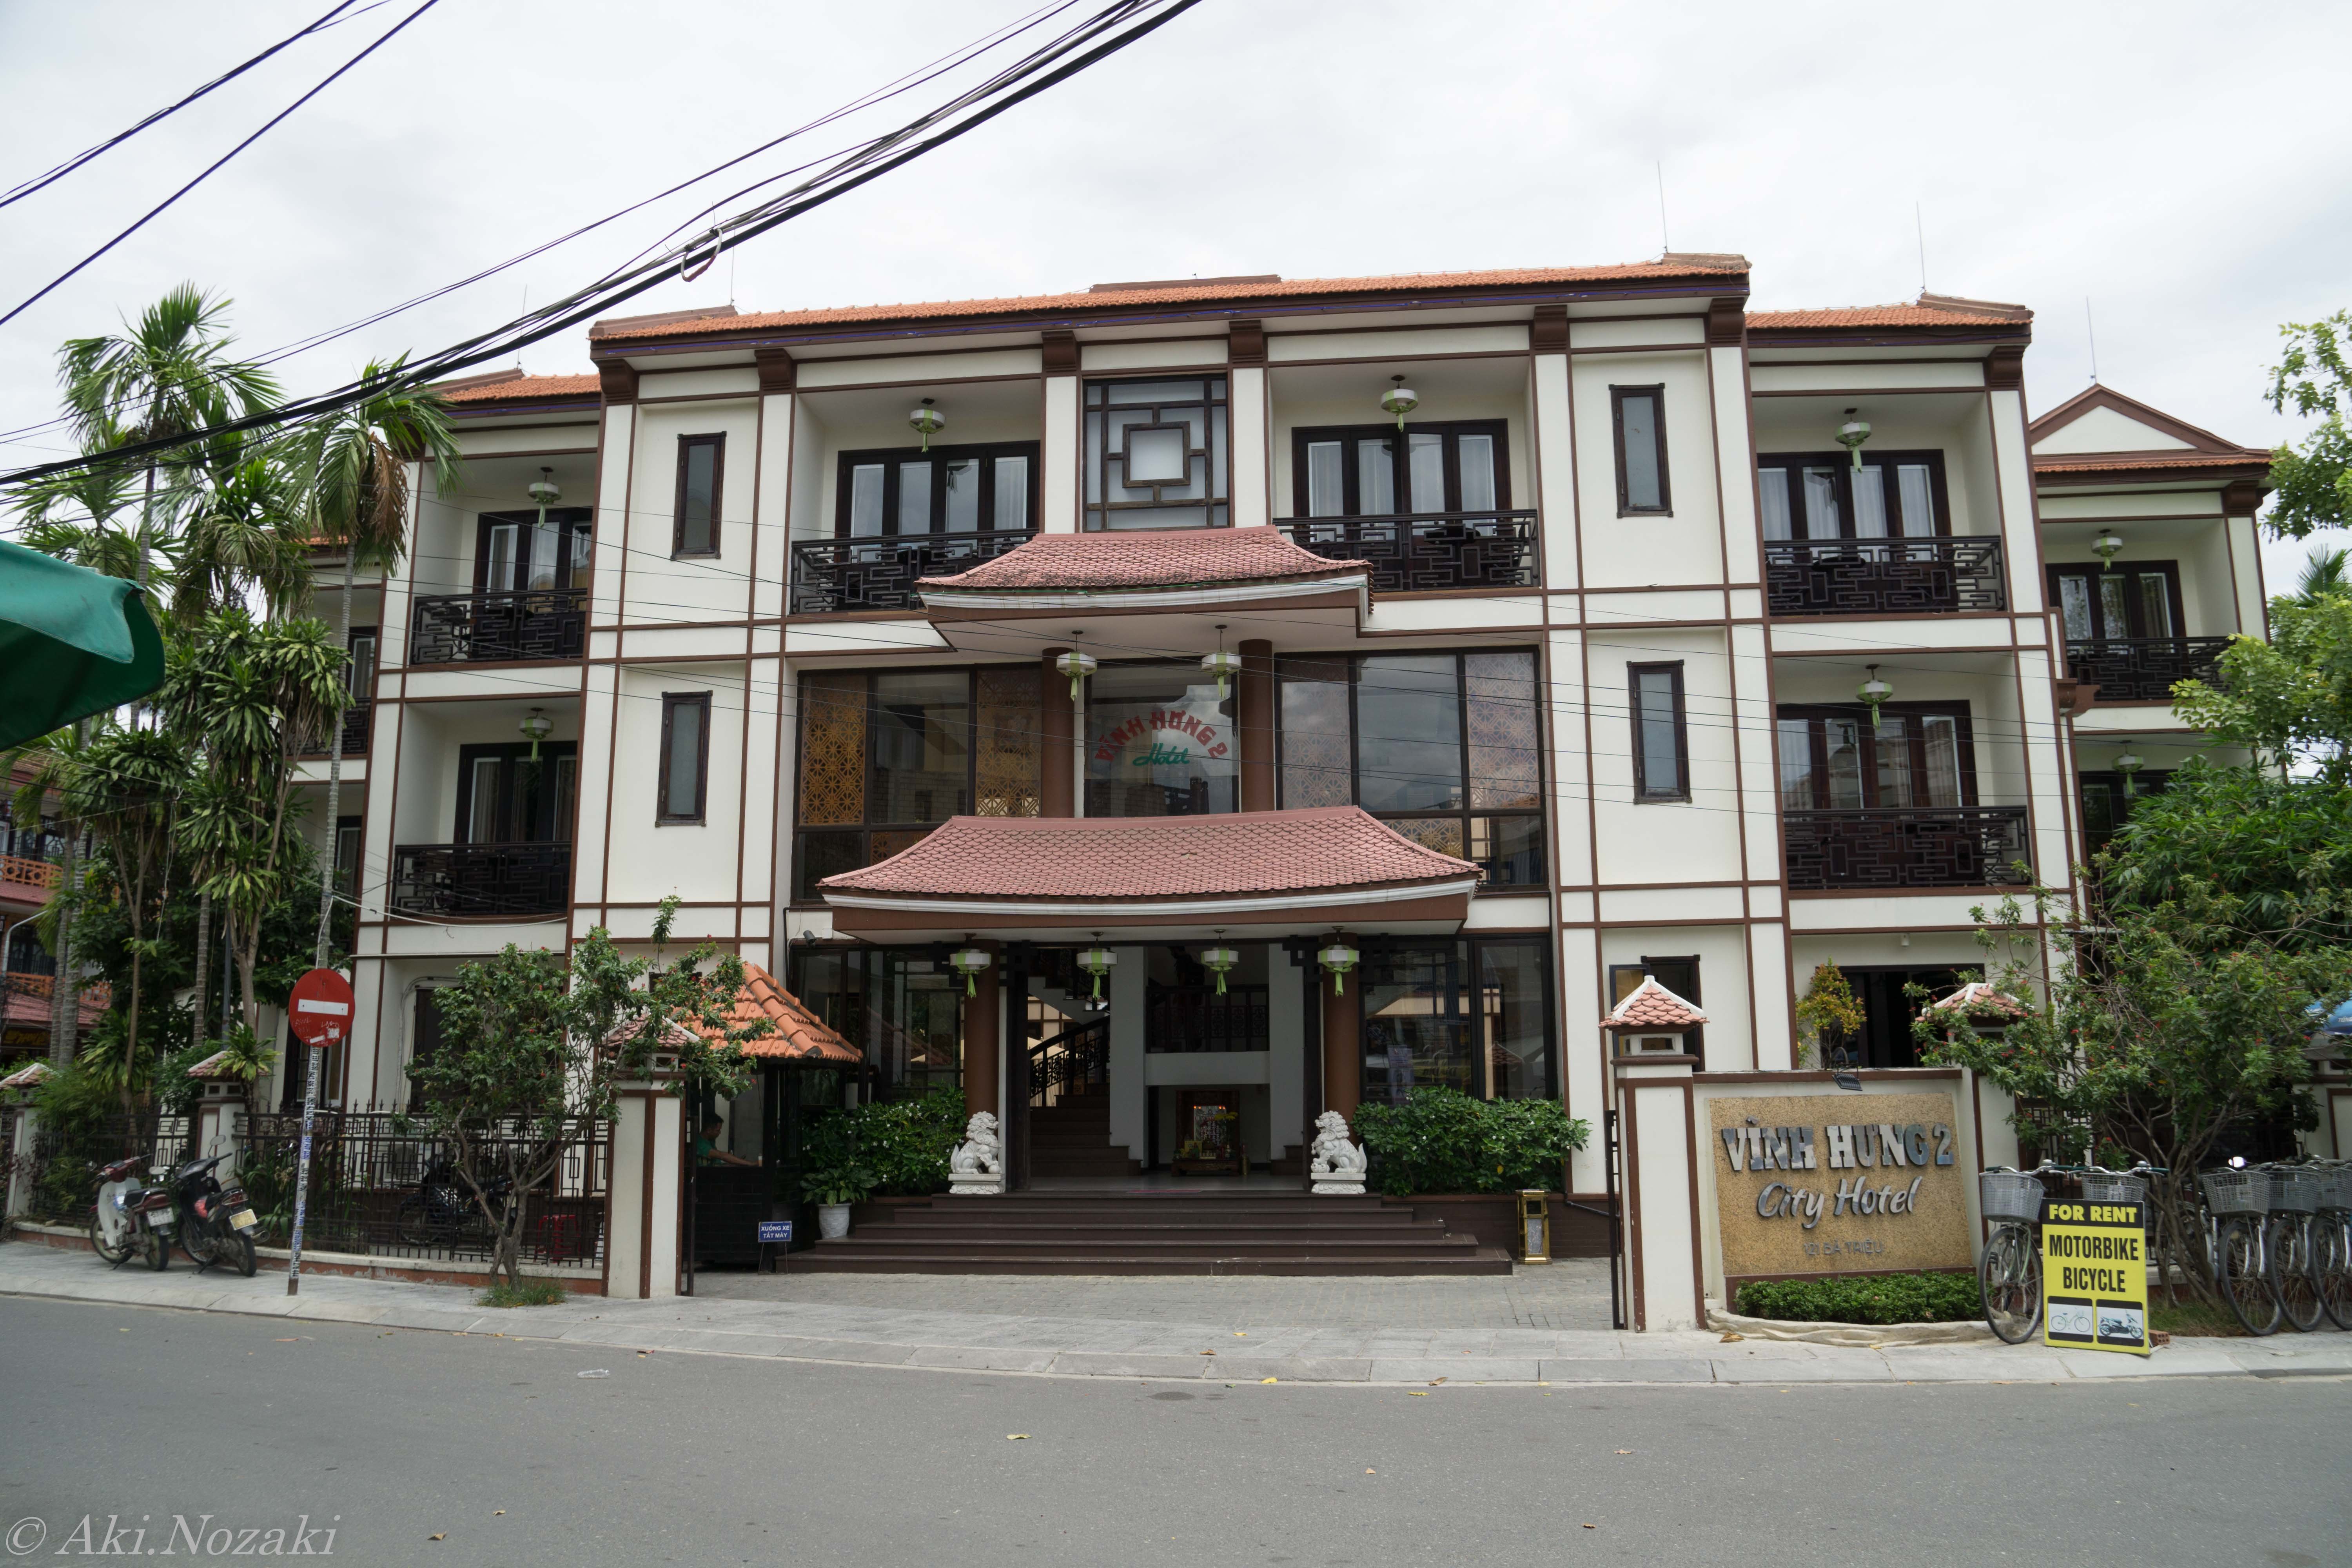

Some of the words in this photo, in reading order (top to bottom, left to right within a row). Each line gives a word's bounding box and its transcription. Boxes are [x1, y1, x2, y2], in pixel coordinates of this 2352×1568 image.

[1132, 743, 1190, 766] Hotel
[1207, 741, 1228, 759] 2
[1825, 1124, 1929, 1168] HƯNG
[1933, 1123, 1954, 1165] 2
[1757, 1181, 1825, 1229] City
[1834, 1176, 1923, 1216] Hotel
[2049, 1204, 2085, 1221] FOR
[2090, 1205, 2137, 1223] RENT
[2049, 1234, 2139, 1261] MOTORBIKE
[2062, 1267, 2126, 1293] BICYCLE
